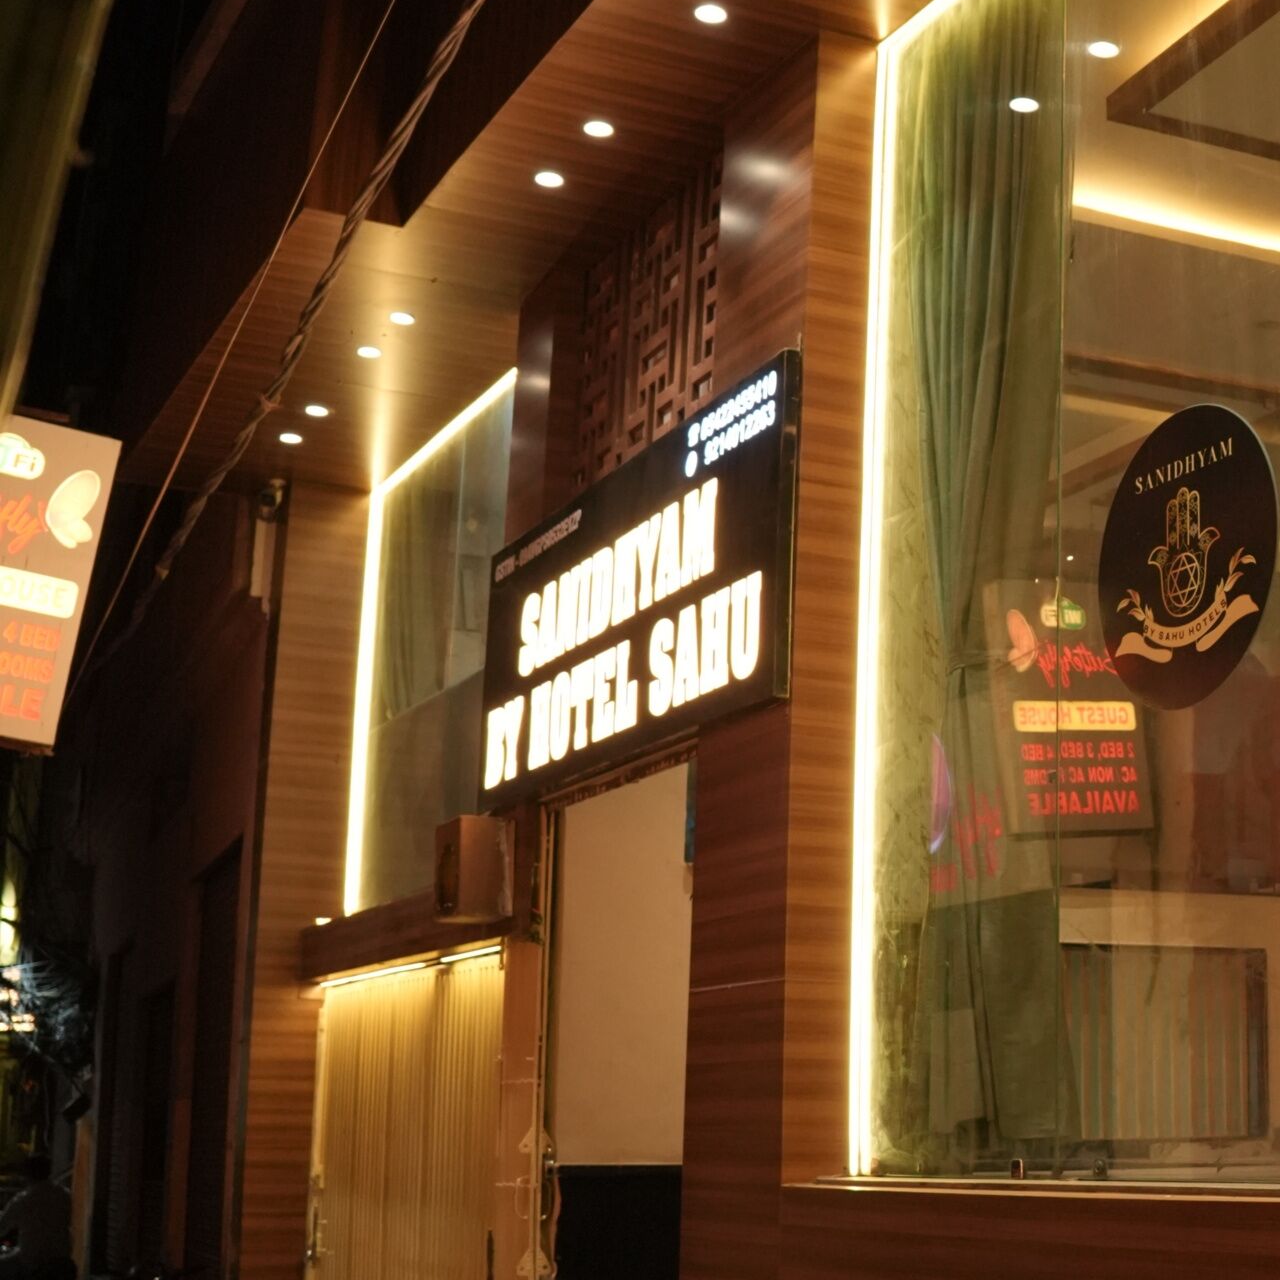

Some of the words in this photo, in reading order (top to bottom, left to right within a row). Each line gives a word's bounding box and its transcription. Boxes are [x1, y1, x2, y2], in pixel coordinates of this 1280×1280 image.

[1135, 437, 1233, 495] SANIDHYAM
[518, 477, 719, 677] SANIDHYAM
[1144, 624, 1156, 635] BY
[1158, 631, 1186, 641] SAHU
[1188, 599, 1227, 636] HOTELS
[484, 695, 524, 790] BY
[528, 639, 638, 771] HOTEL
[648, 570, 763, 716] SAHU
